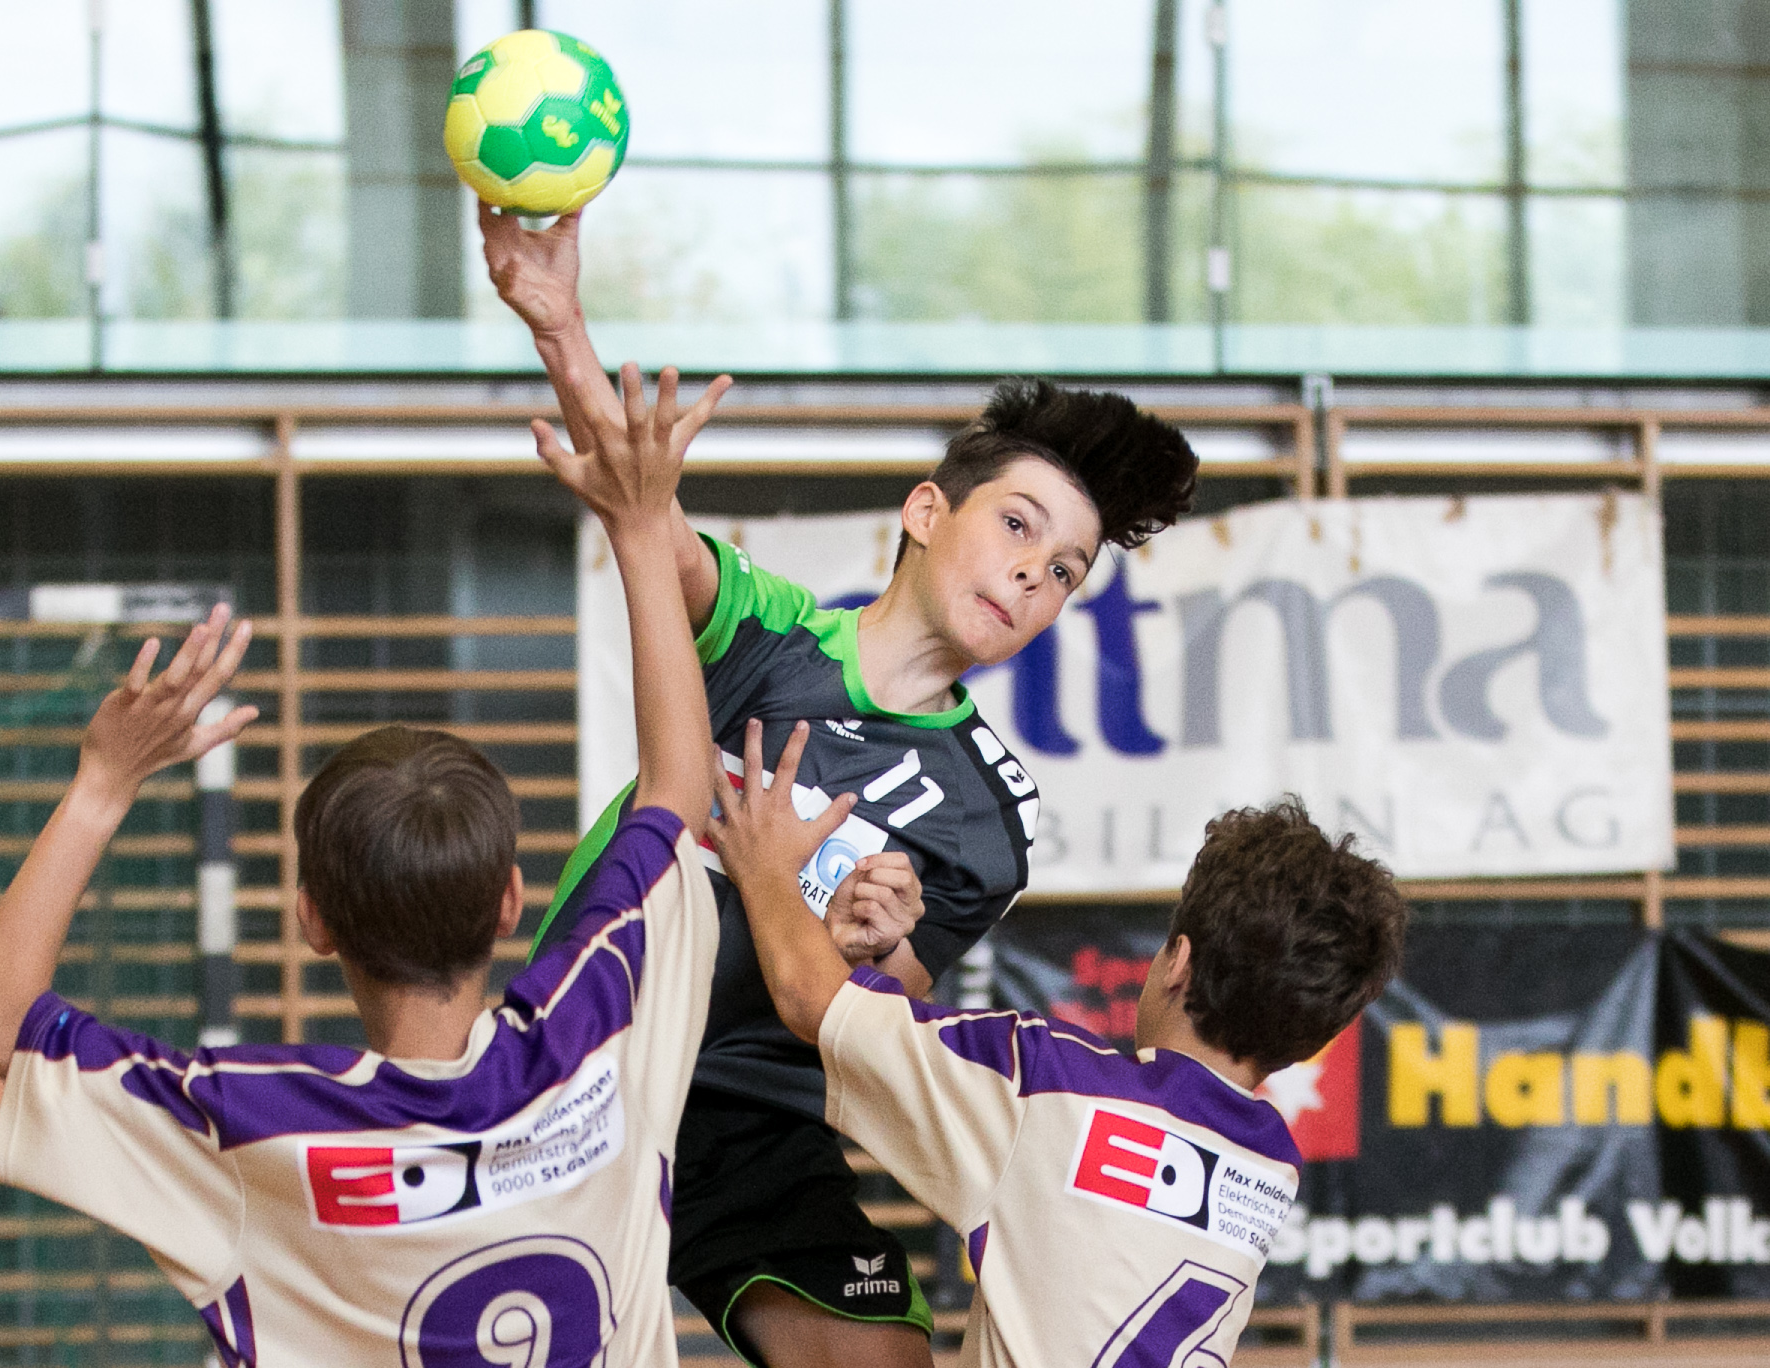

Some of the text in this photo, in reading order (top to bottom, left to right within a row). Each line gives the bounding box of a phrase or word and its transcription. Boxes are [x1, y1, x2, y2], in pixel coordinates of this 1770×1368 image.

[1470, 786, 1624, 853] AG
[491, 1172, 535, 1196] 9000
[1223, 1166, 1251, 1188] Max
[1218, 1219, 1247, 1240] 9000
[843, 1277, 901, 1297] erima
